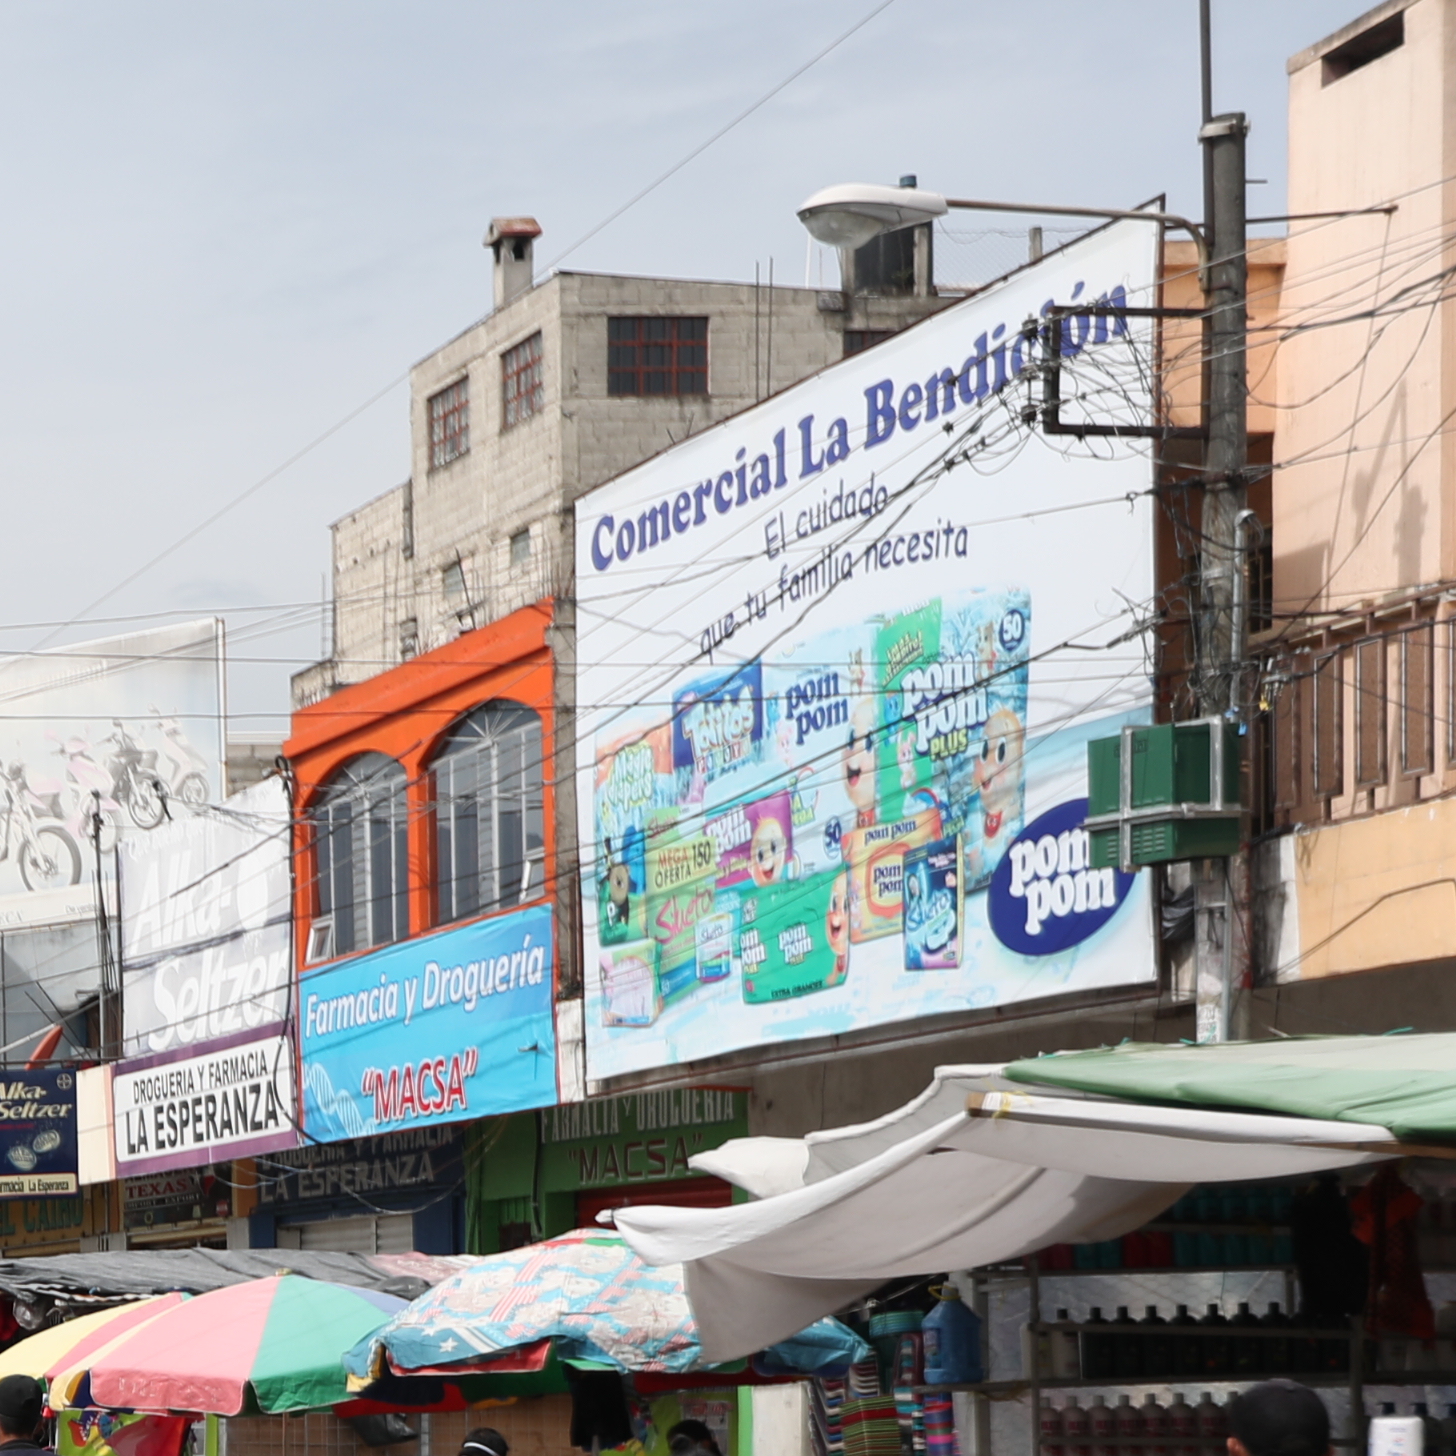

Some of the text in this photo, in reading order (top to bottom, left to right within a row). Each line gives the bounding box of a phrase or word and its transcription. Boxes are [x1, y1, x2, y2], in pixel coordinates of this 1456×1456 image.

[592, 281, 1130, 571] Comercial La Bendición
[764, 472, 888, 560] El cuidado
[700, 521, 969, 662] que tu familia necesita
[1003, 613, 1022, 642] 50
[785, 672, 840, 720] pom
[901, 653, 976, 714] pom
[796, 698, 849, 746] pom
[915, 686, 988, 755] pom
[929, 728, 969, 762] PLUS
[1025, 865, 1117, 936] pom
[148, 948, 290, 1051] Seltzer
[305, 935, 546, 1040] Farmacia y Droguería
[133, 1048, 268, 1101] DROGUERIA Y FARMACIA
[125, 1084, 279, 1156] LA ESPERANZA
[28, 1179, 37, 1193] La
[37, 1178, 70, 1195] Esperanza
[125, 1178, 189, 1200] TEXAS
[298, 1152, 434, 1199] ESPERANZA
